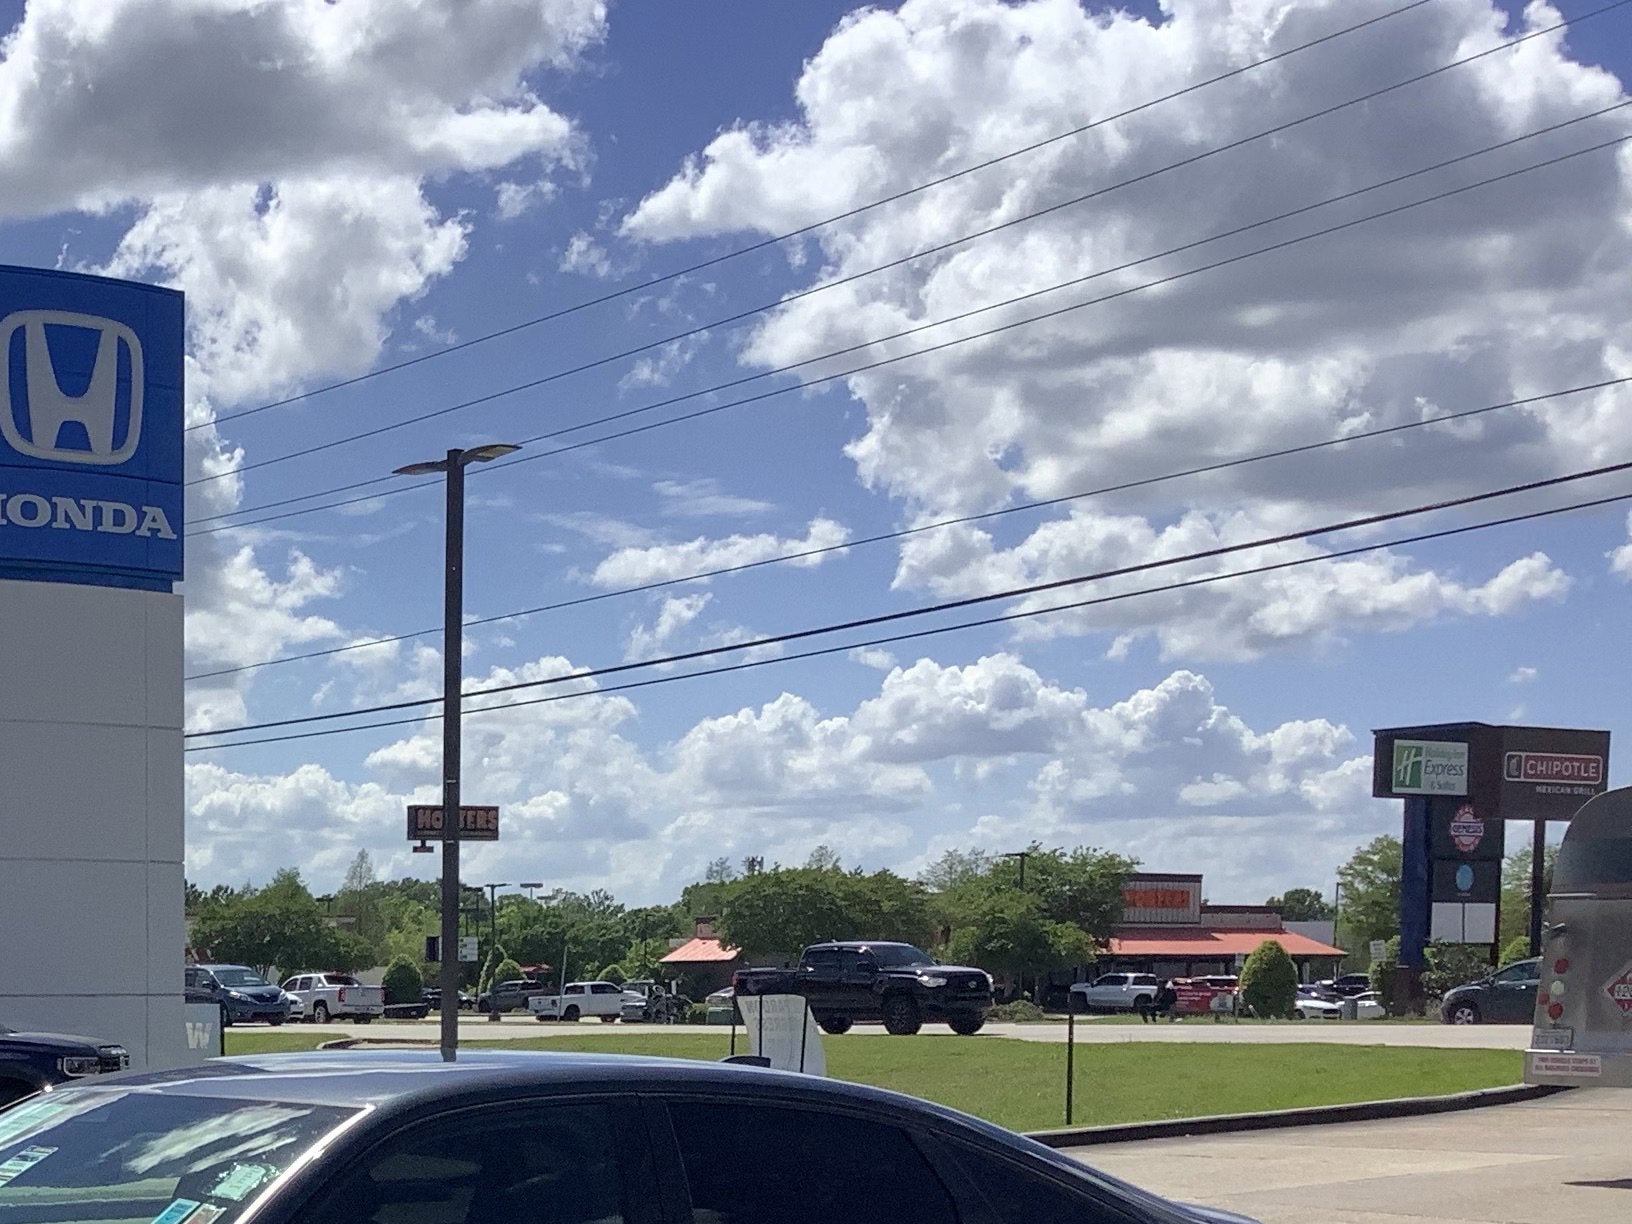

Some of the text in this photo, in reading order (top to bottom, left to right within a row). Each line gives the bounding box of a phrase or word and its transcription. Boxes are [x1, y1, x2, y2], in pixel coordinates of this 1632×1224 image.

[1424, 759, 1465, 779] Express
[1526, 760, 1598, 777] CHIPOTLE
[1535, 785, 1596, 796] MEXICAN GRILL
